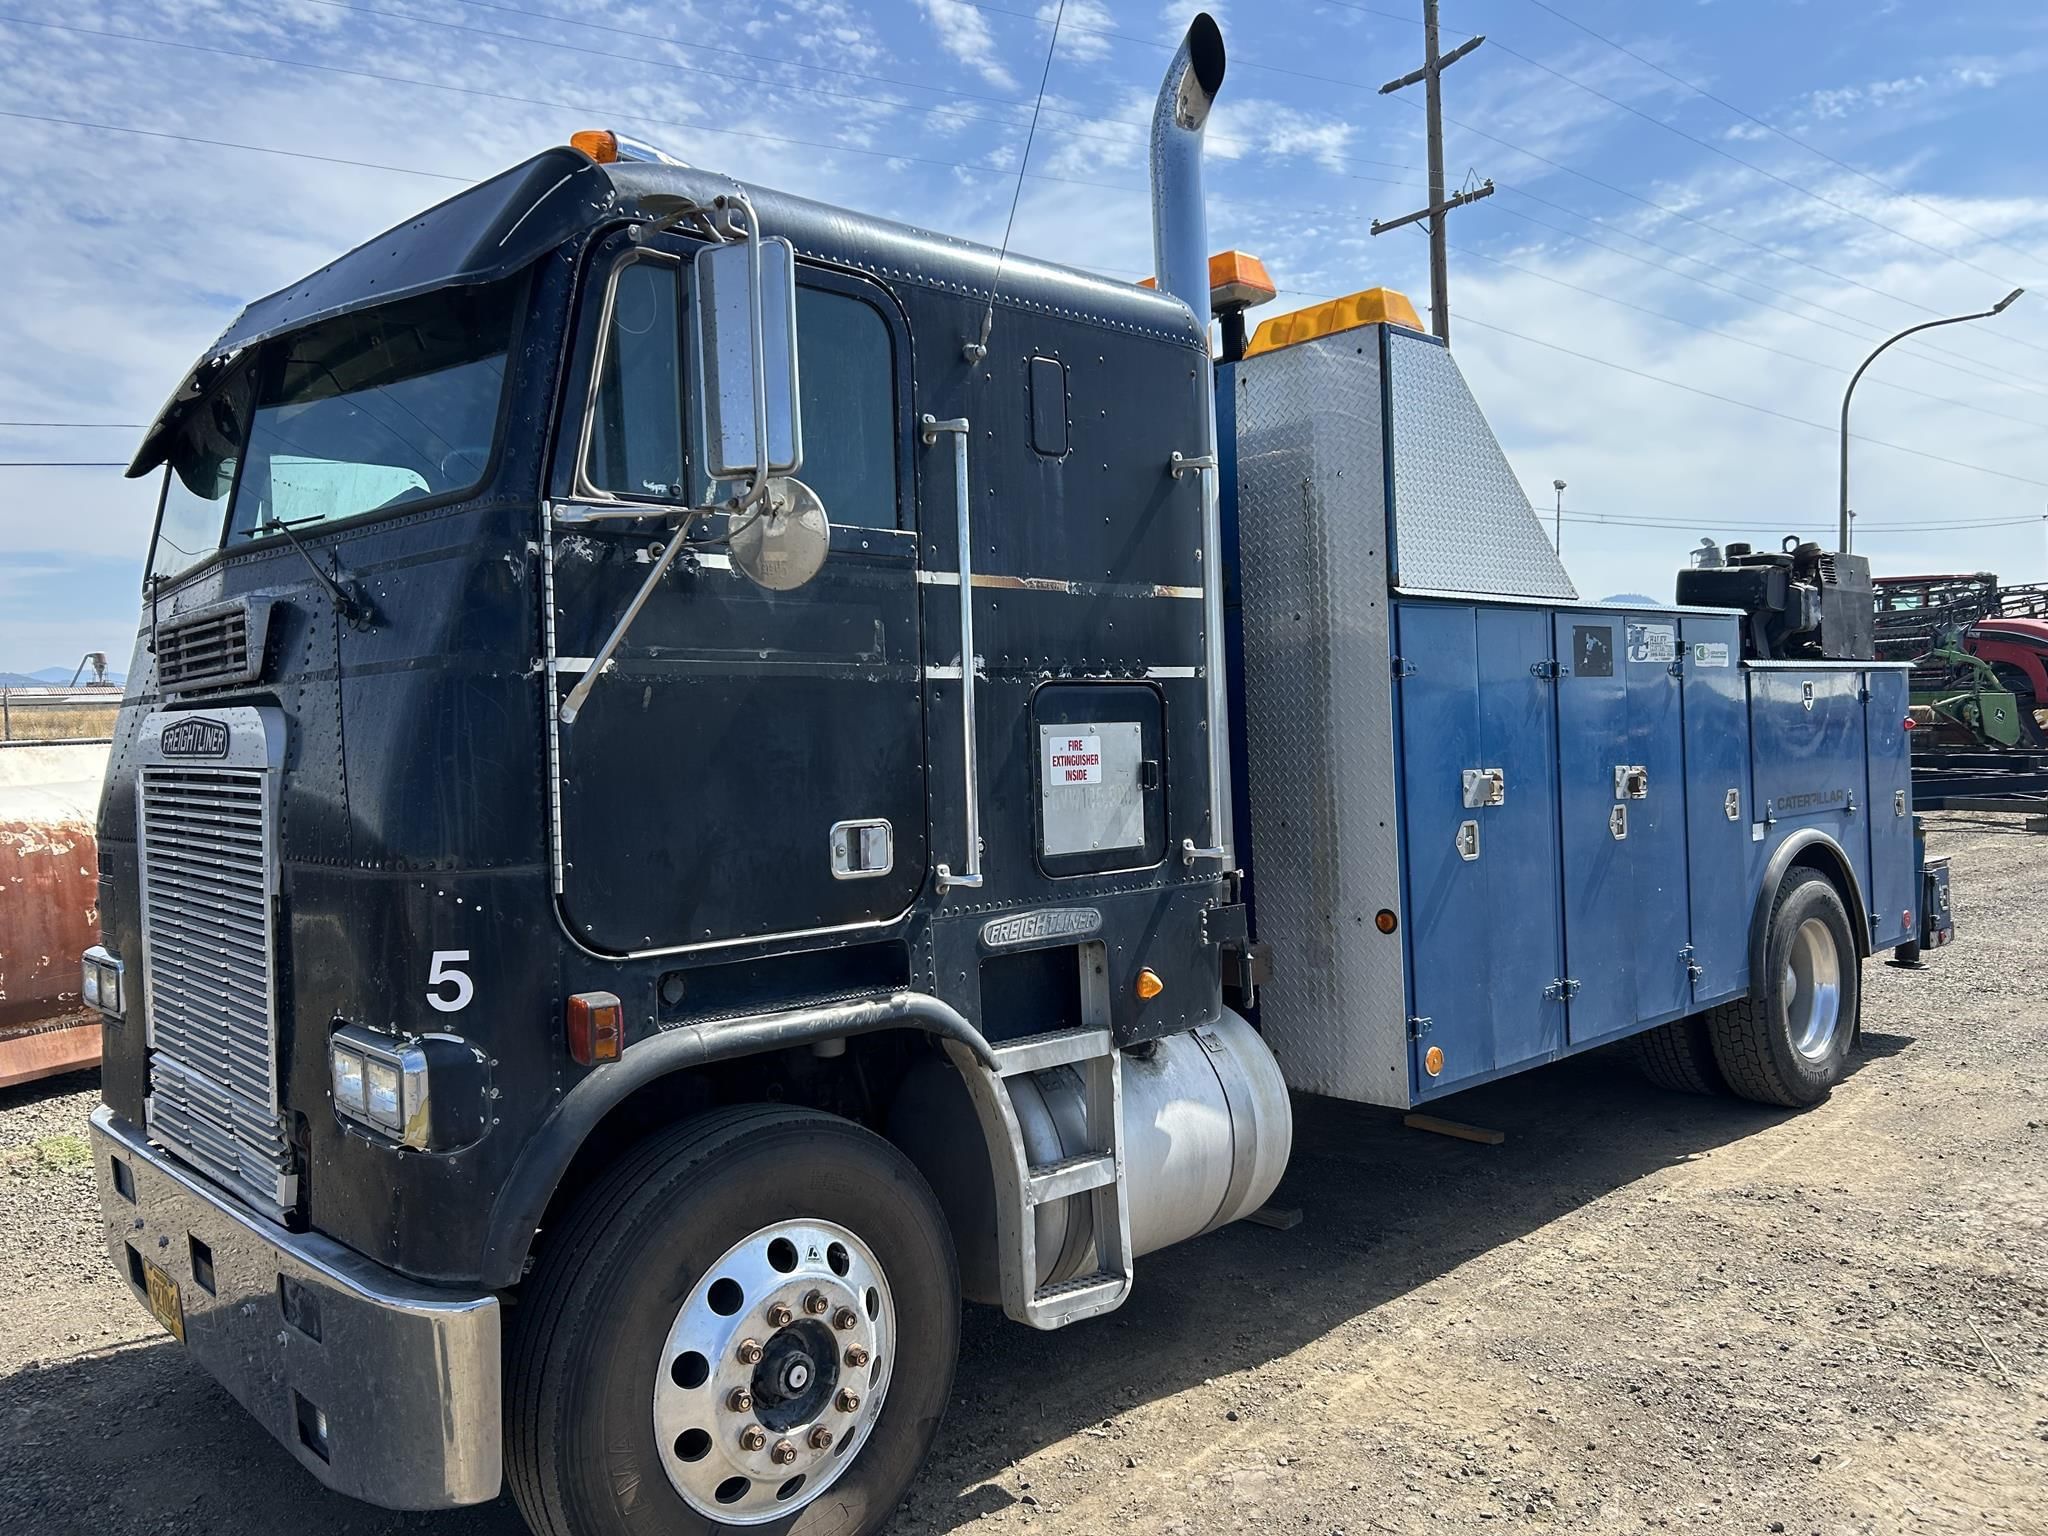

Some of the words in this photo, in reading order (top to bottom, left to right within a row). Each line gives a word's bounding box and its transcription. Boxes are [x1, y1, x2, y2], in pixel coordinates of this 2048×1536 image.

[162, 723, 225, 752] FREIGHTLINER
[1068, 740, 1083, 752] FIRE
[1052, 754, 1099, 767] EXTINGUISHER
[1065, 769, 1088, 781] INSIDE
[989, 912, 1098, 943] FREIGHTLINER
[426, 950, 474, 1012] 5
